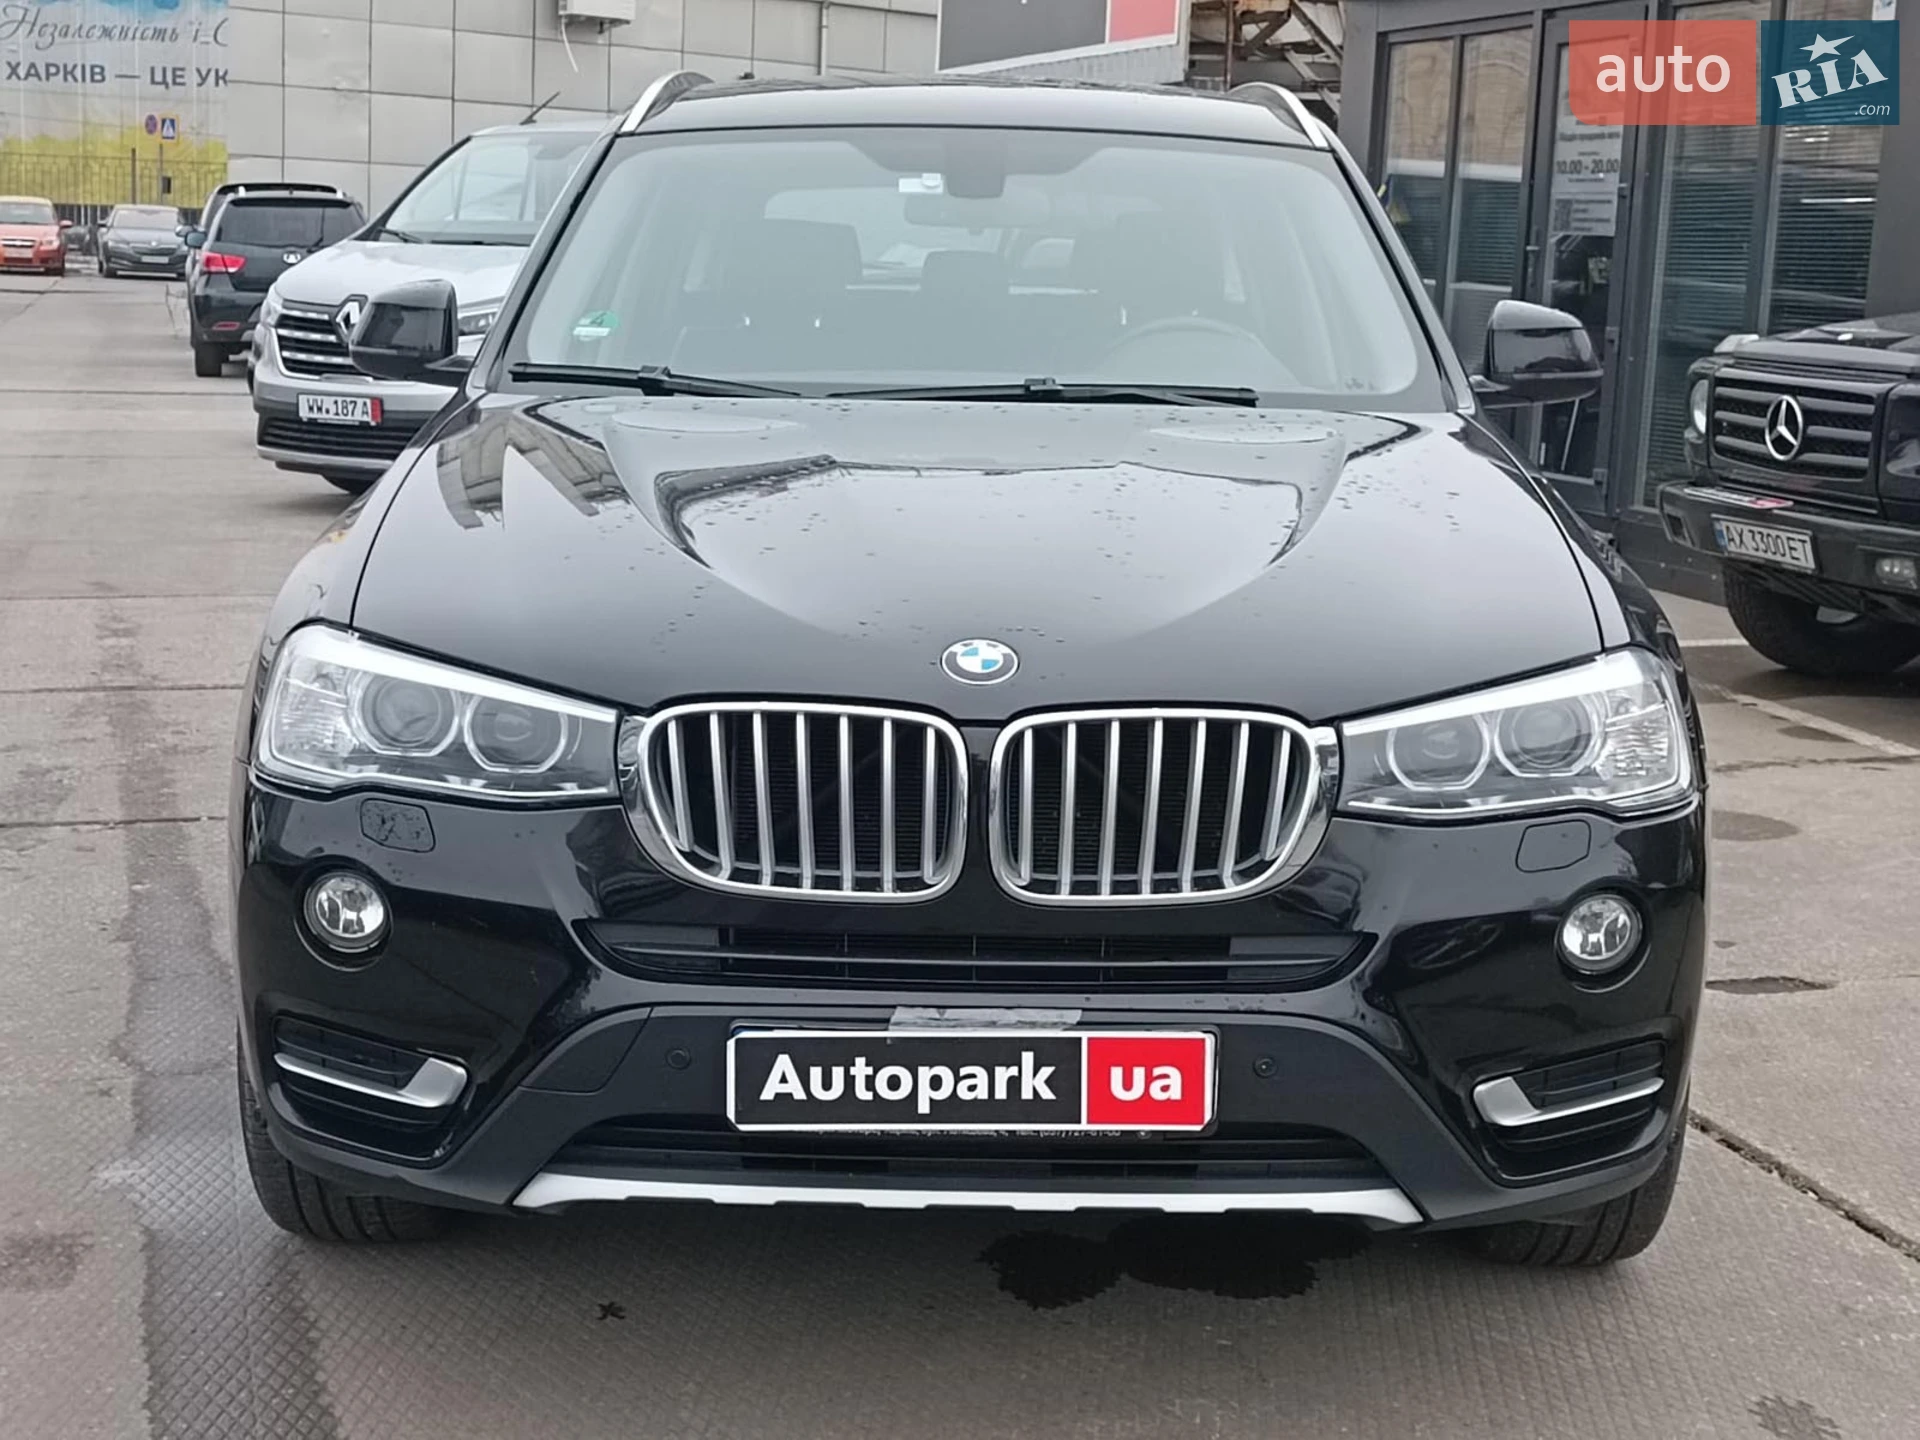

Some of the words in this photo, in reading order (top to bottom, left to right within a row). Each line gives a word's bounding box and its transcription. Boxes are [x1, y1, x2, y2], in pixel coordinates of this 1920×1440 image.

[0, 4, 179, 50] Незалежність
[6, 61, 106, 83] ХАРКІВ
[150, 66, 186, 89] ЦЕ
[759, 1051, 1056, 1115] Autopark
[1109, 1065, 1183, 1100] ua
